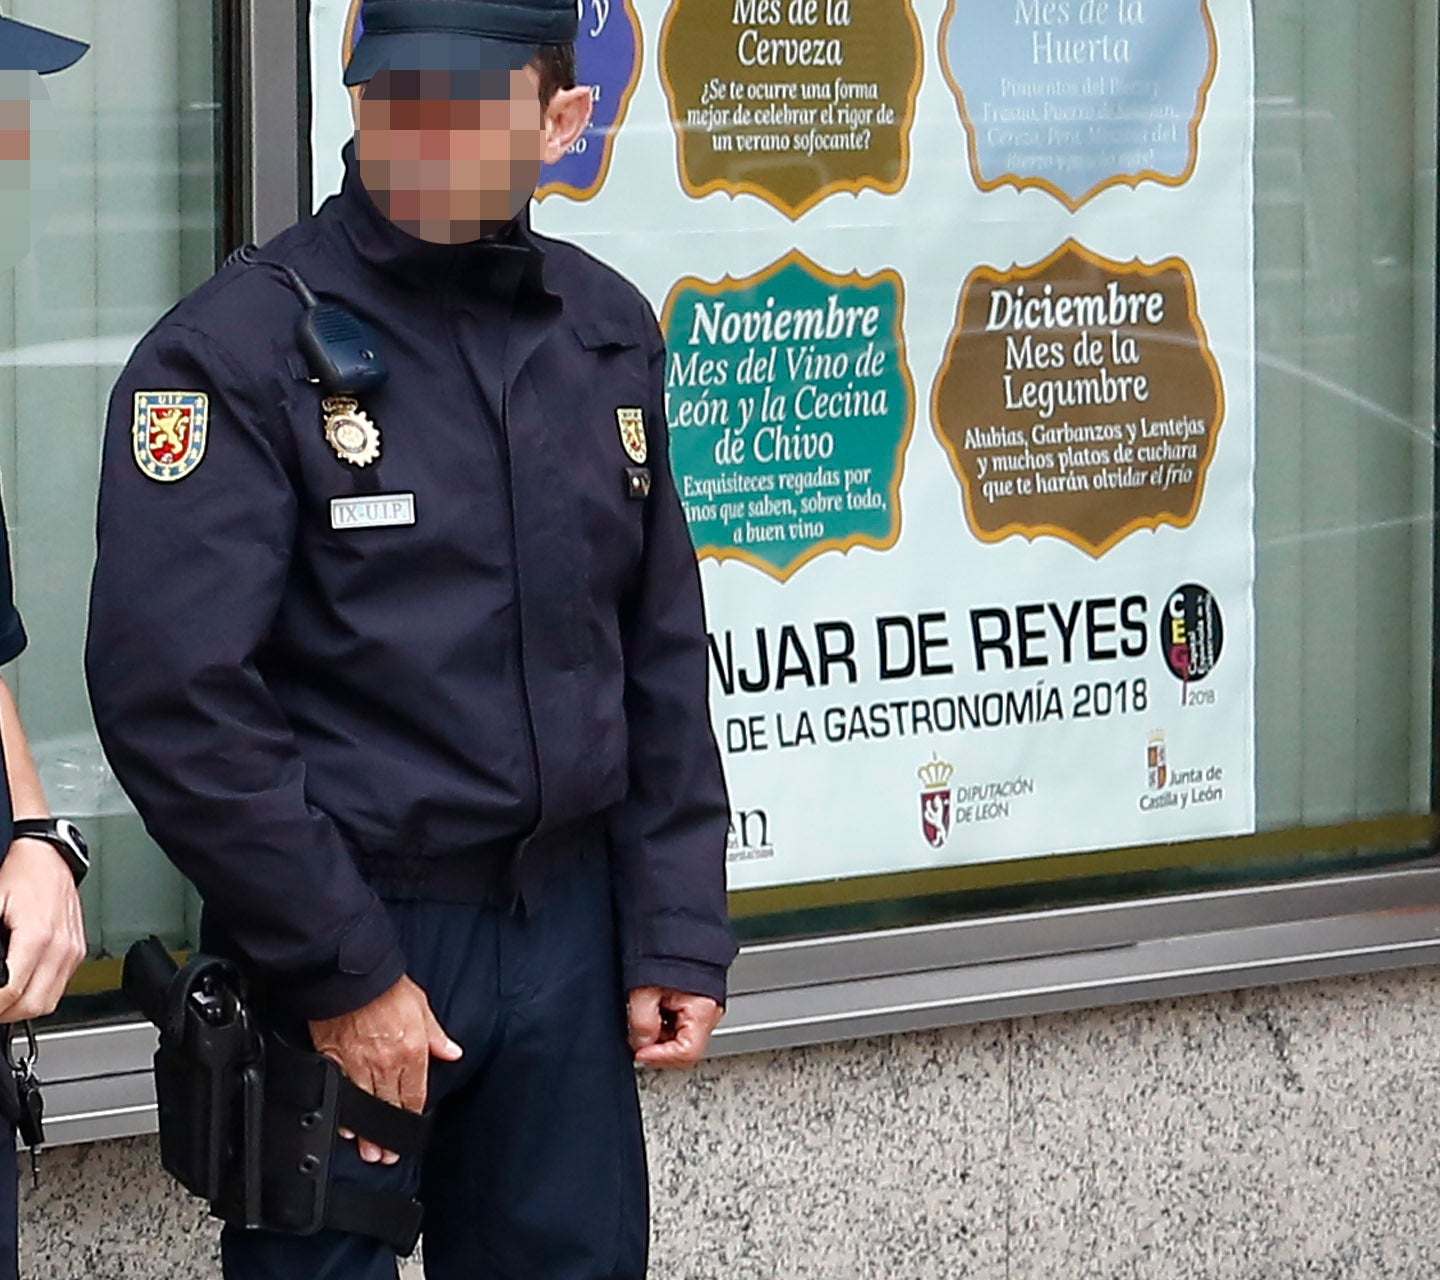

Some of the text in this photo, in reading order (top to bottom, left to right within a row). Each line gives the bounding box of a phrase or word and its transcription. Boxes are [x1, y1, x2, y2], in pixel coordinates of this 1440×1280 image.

[739, 30, 842, 65] Cerveza
[1034, 32, 1128, 64] Huerta
[689, 294, 879, 344] Noviembre
[985, 282, 1163, 331] Diciembre
[668, 342, 885, 387] Mes del Vino de
[1006, 329, 1139, 370] Mes de la
[664, 382, 888, 435] León y la Cecina
[1004, 368, 1148, 418] Legumbre
[715, 425, 833, 465] de Chivo
[965, 416, 1205, 449] Alubias, Garbanzos y Lentejas
[977, 440, 1196, 479] y muchos platos de cuchara
[684, 466, 871, 501] Exquisiteces regadas por
[983, 464, 1192, 502] que te harán olvidar el frío
[877, 612, 953, 680] DE
[970, 596, 1147, 670] REYES
[727, 678, 1147, 753] DE LA GASTRONOMÍA 2018
[957, 776, 1033, 803] DIPUTACIÓN
[1170, 766, 1222, 786] Junta de
[956, 799, 1008, 823] DE LEÓN
[1140, 786, 1222, 811] Castilla y León
